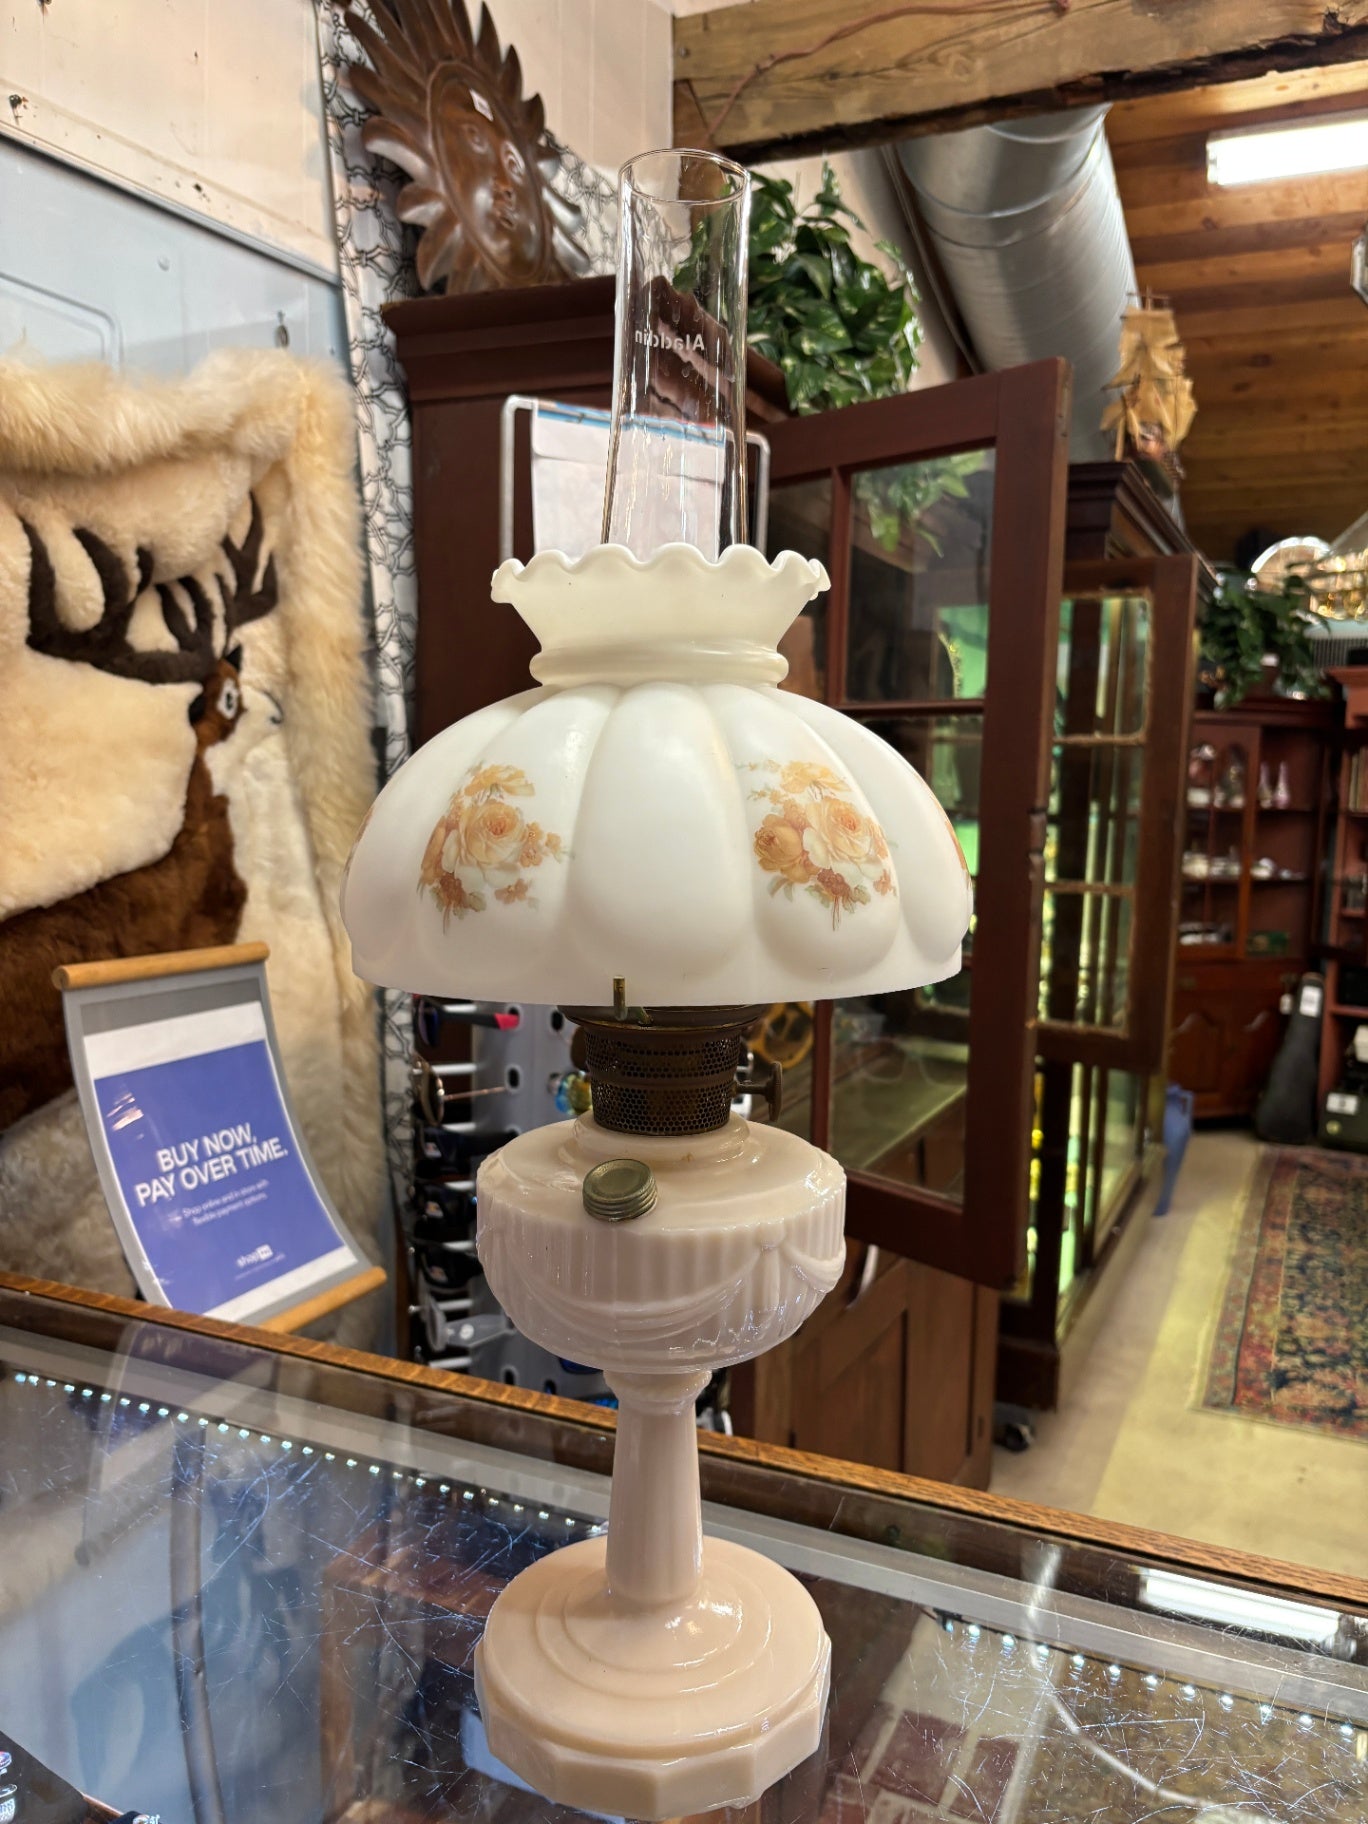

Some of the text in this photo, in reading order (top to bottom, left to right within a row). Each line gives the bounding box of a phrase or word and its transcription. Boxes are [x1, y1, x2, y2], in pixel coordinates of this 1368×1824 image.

[134, 1136, 289, 1208] PAY OVER TIME.
[156, 1138, 199, 1172] BUY
